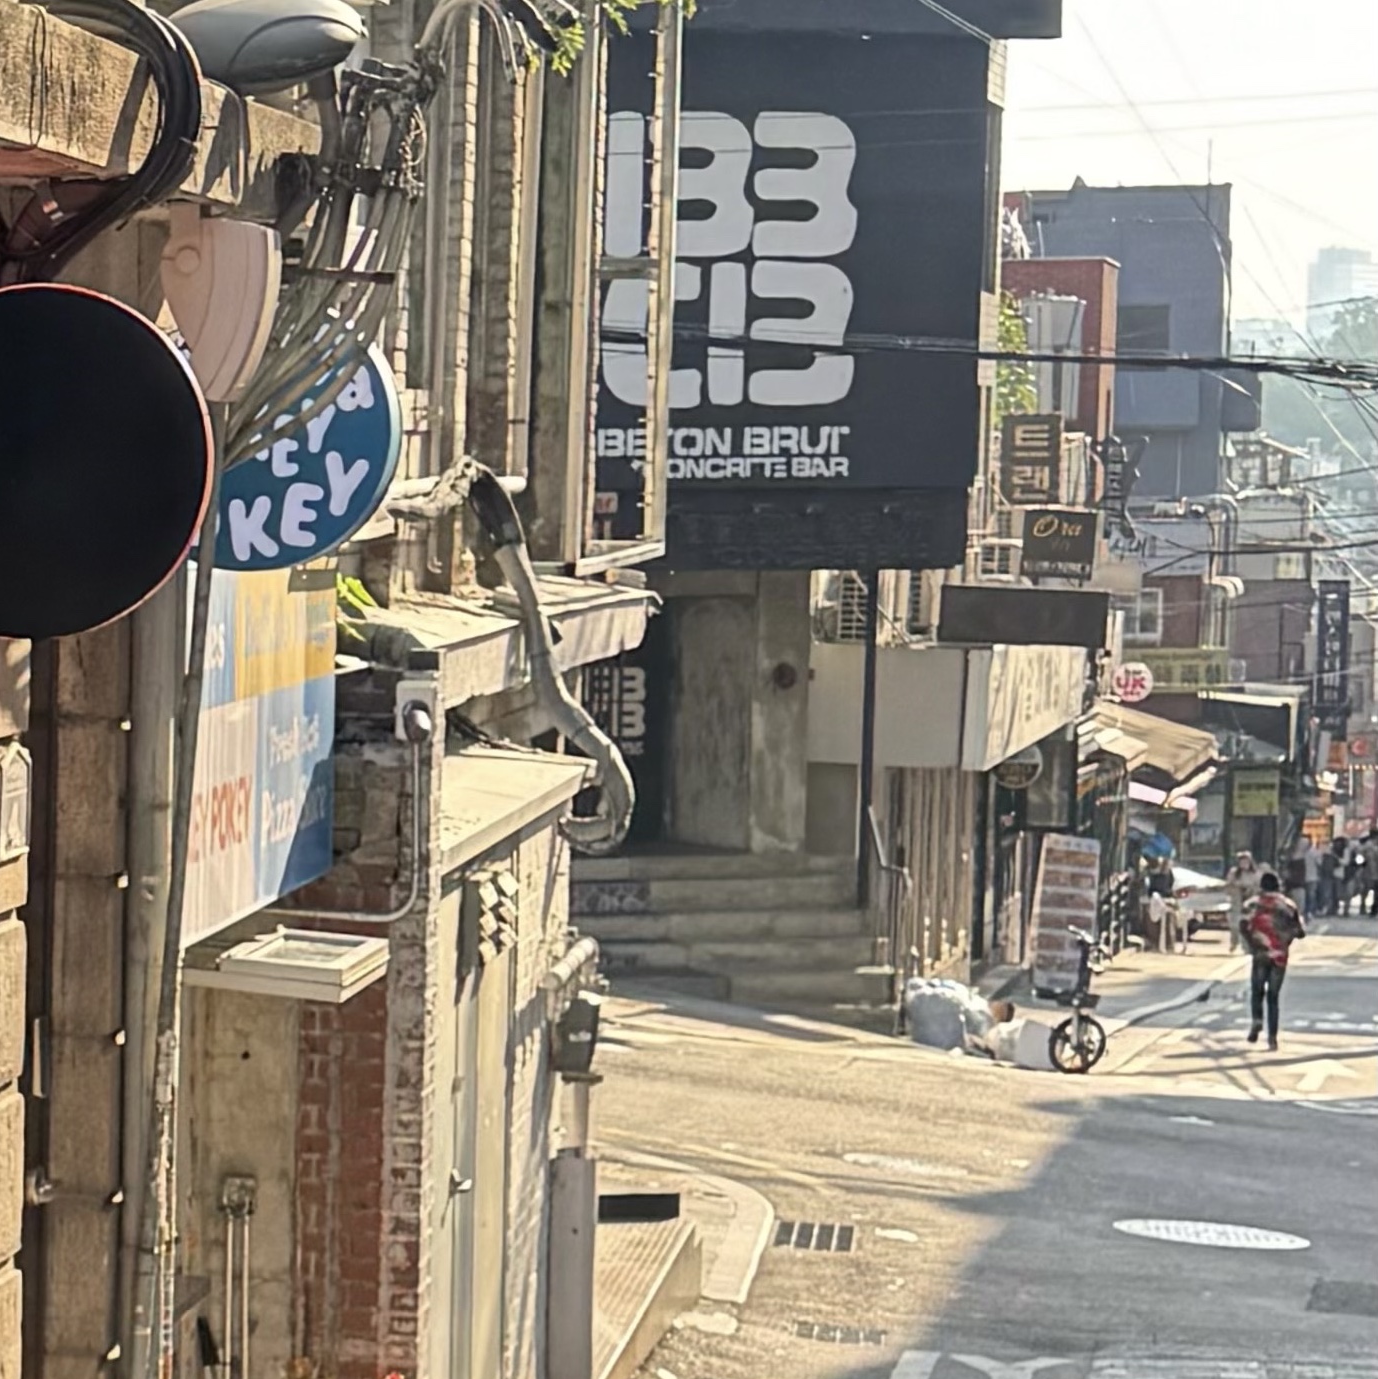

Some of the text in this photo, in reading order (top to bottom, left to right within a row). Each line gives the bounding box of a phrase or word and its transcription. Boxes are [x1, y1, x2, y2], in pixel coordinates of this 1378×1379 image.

[597, 426, 851, 457] BEON BRUT
[631, 456, 850, 479] ONCRETE BAR
[215, 451, 370, 561] KEY
